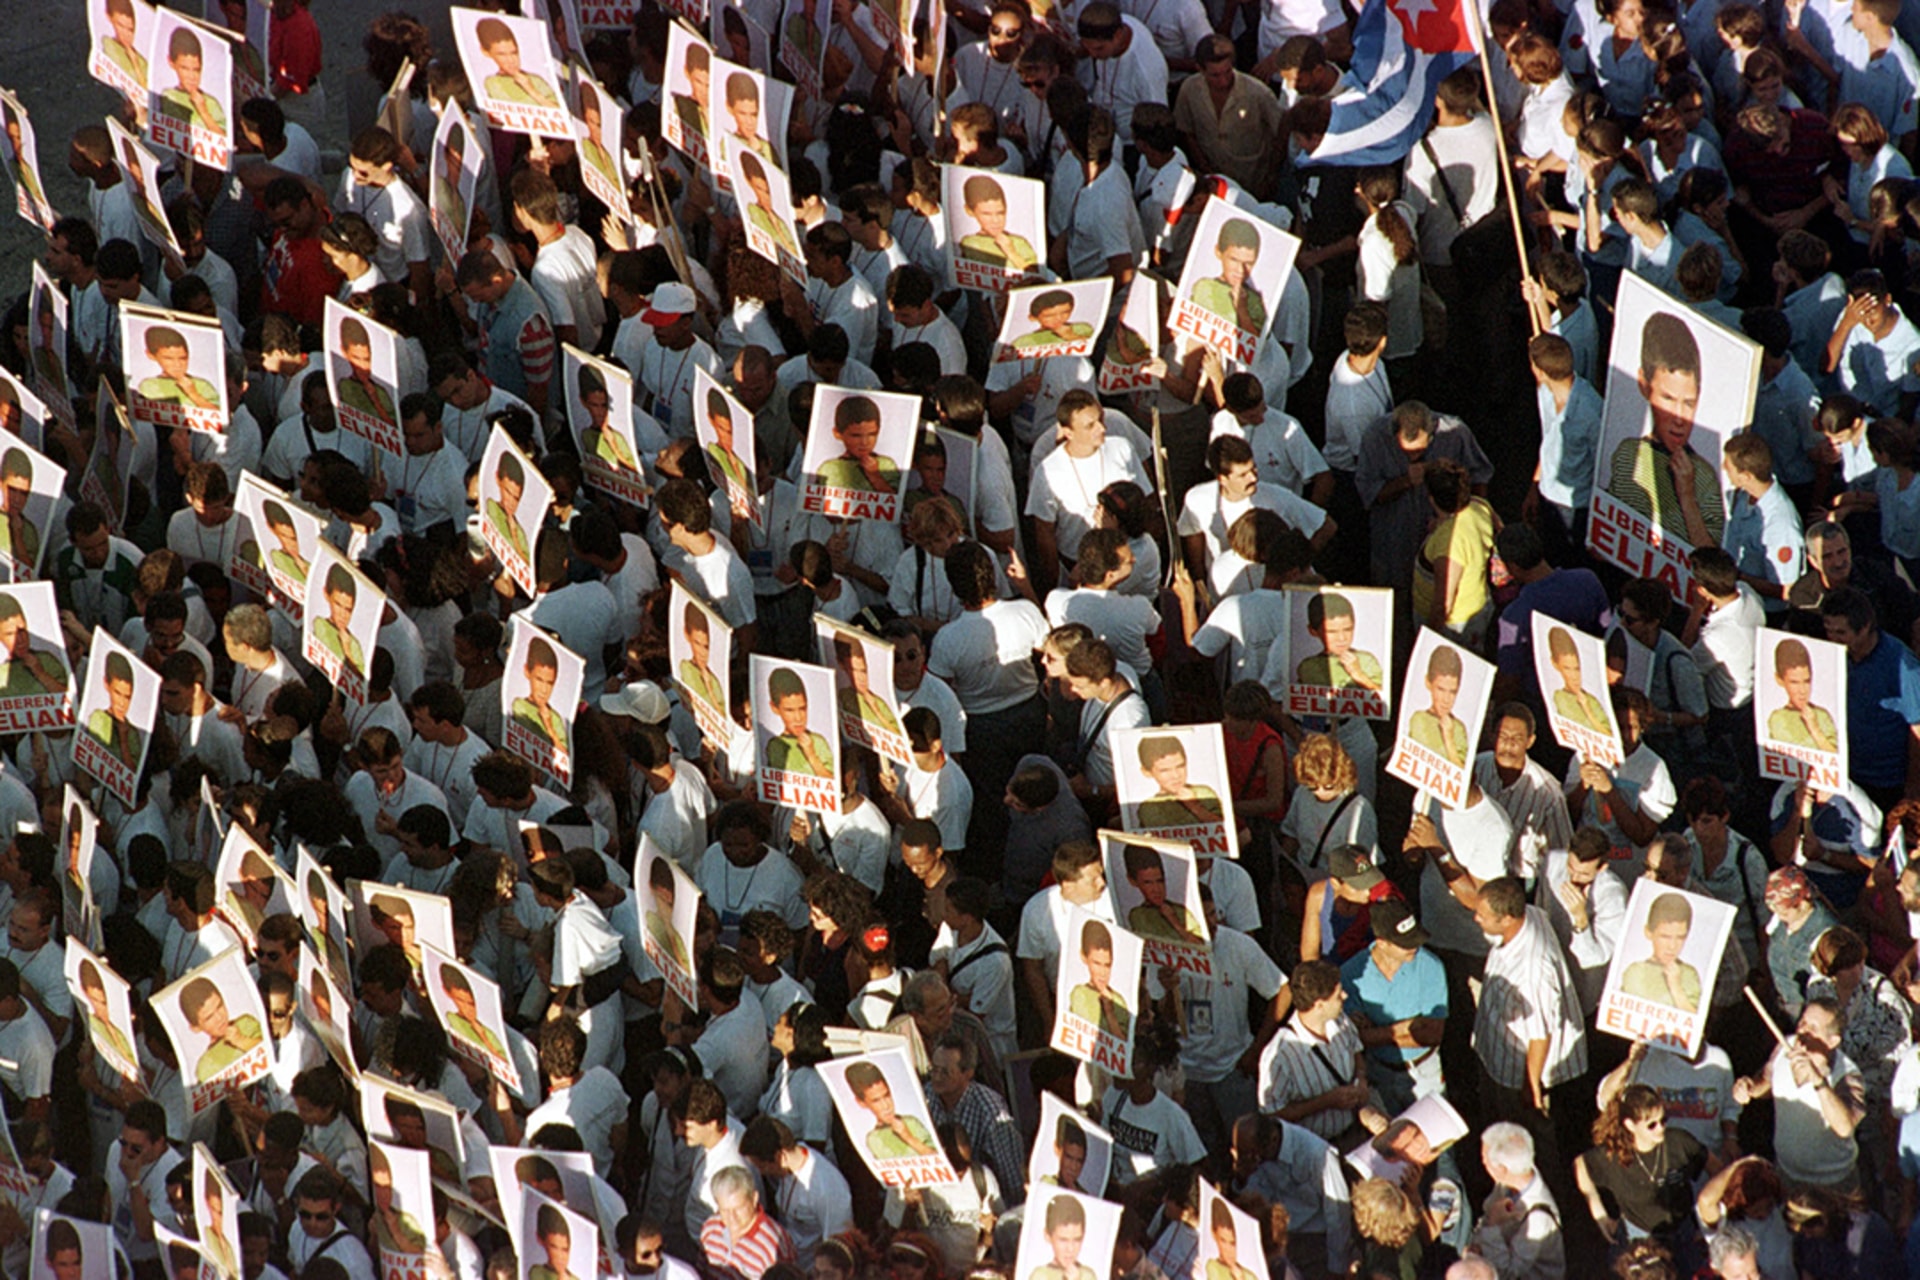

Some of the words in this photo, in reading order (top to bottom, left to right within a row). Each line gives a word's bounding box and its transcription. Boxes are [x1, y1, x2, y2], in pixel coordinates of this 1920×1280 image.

[581, 8, 634, 25] IAN
[483, 99, 552, 119] LIBEREN
[553, 108, 564, 119] A
[487, 111, 569, 136] ELIAN
[151, 112, 213, 142] LIBEREN
[218, 136, 227, 147] A
[151, 124, 228, 167] ELIAN
[1176, 312, 1256, 366] ELIAN
[1180, 300, 1244, 337] LIBEREN
[1246, 337, 1257, 348] A
[1102, 372, 1153, 391] IAN
[132, 398, 203, 417] LIBEREN
[209, 411, 222, 420] A
[134, 408, 223, 434] ELIAN
[338, 403, 390, 431] LIBEREN
[391, 427, 399, 438] A
[339, 413, 402, 457] ELIAN
[803, 497, 897, 522] ELIAN
[806, 485, 881, 502] LIBEREN
[885, 493, 897, 505] A
[481, 521, 531, 592] ELIAN
[307, 644, 365, 707] ELIAN
[1290, 685, 1366, 700] LIBEREN
[1372, 691, 1382, 700] A
[1290, 697, 1383, 717] ELIAN
[77, 730, 126, 777] LIBEREN
[127, 772, 136, 784] A
[506, 731, 569, 784] ELIAN
[844, 723, 911, 764] ELIAN
[1401, 739, 1451, 774] LIBEREN
[1453, 771, 1463, 783] A
[1561, 729, 1620, 768] ELIAN
[1764, 742, 1824, 767] LIBEREN
[1828, 755, 1839, 767] A
[74, 746, 134, 801] ELIAN
[762, 768, 822, 789] LIBEREN
[825, 780, 836, 792] A
[1396, 751, 1462, 804] ELIAN
[1765, 755, 1840, 788] ELIAN
[763, 783, 837, 813] ELIAN
[1215, 824, 1225, 834] A
[645, 940, 694, 1004] ELIAN
[1610, 993, 1681, 1023] LIBEREN
[1683, 1017, 1694, 1028] A
[1062, 1012, 1114, 1048] LIBEREN
[1118, 1043, 1126, 1054] A
[1605, 1008, 1692, 1050] ELIAN
[1059, 1027, 1126, 1075] ELIAN
[880, 1166, 954, 1187] ELIAN
